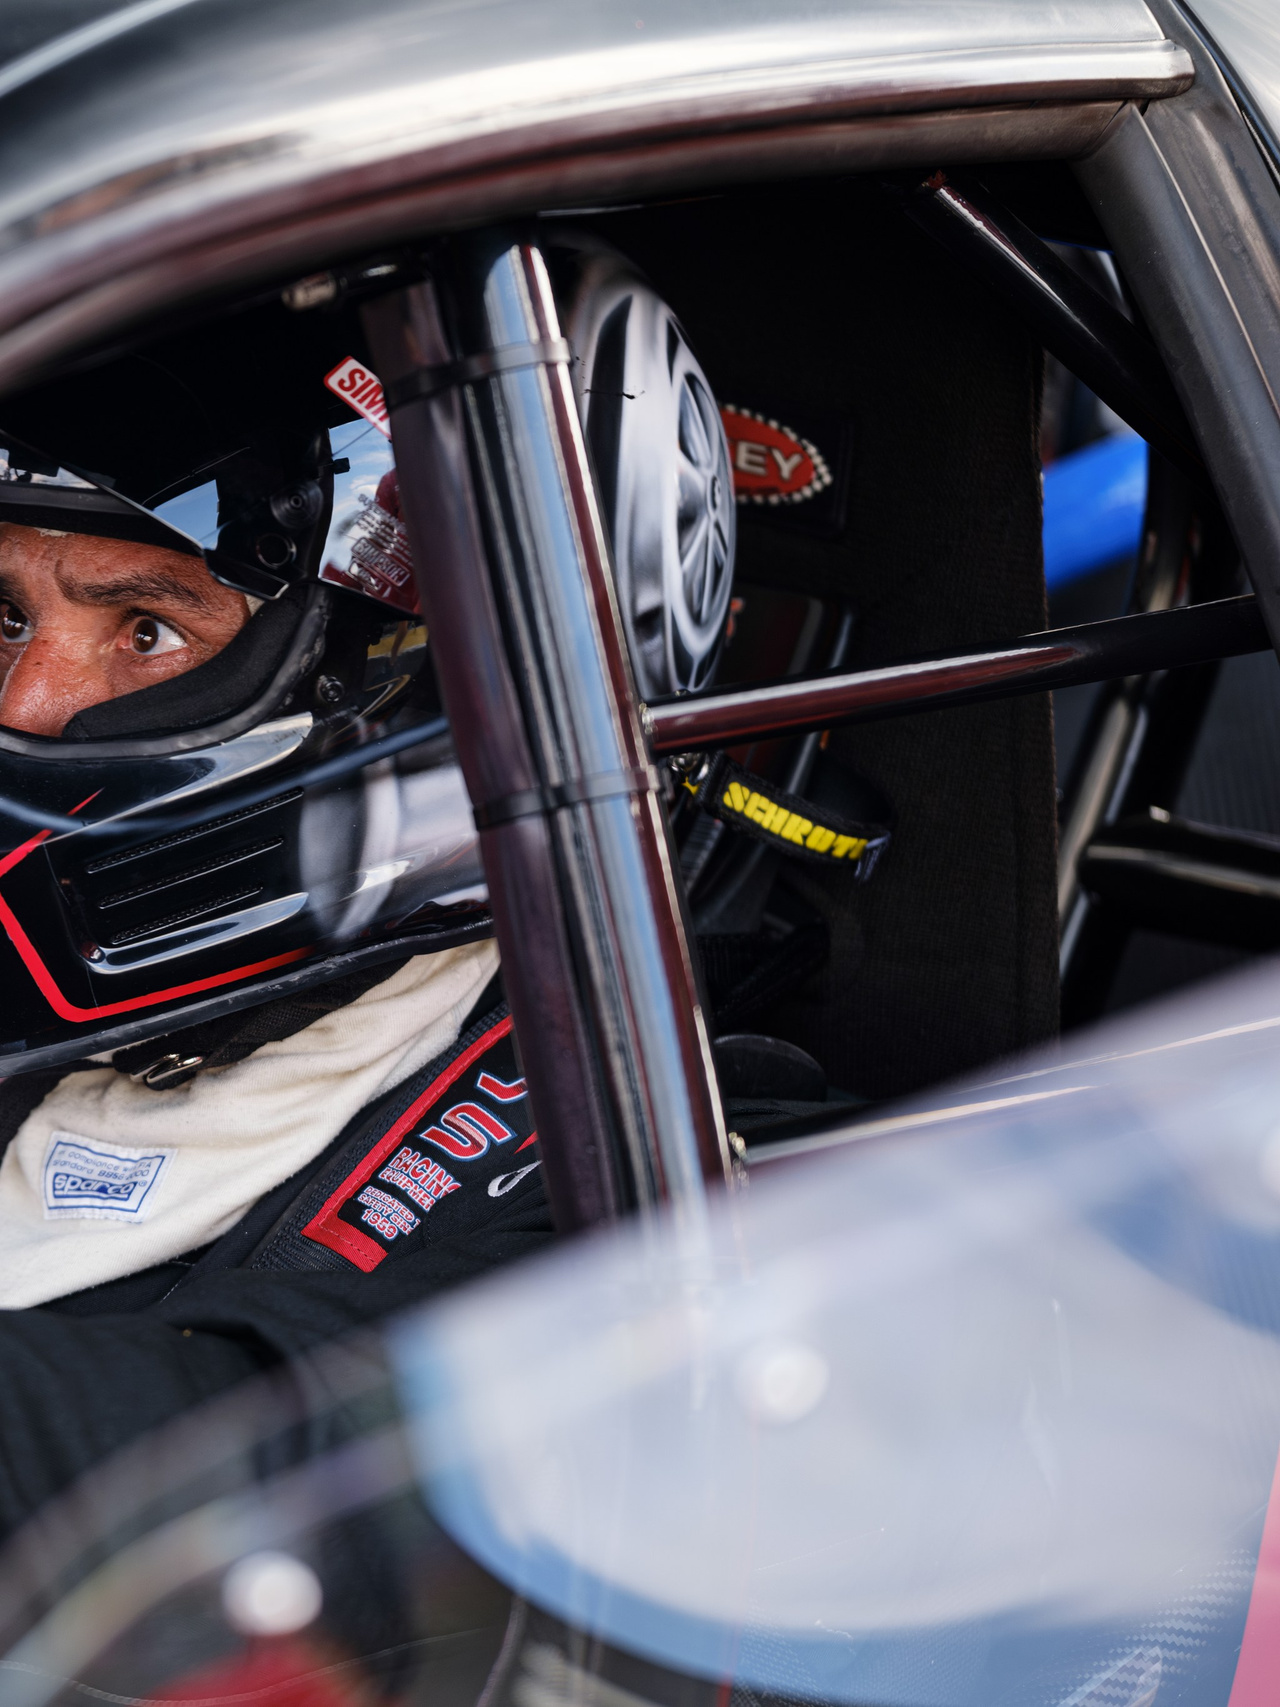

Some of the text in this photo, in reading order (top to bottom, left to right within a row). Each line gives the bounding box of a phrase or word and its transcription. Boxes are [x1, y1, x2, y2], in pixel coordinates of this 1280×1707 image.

[737, 441, 802, 481] EY
[54, 1174, 135, 1195] sparco
[379, 1167, 436, 1212] EQUIPMEN
[357, 1193, 393, 1216] SAFETY
[361, 1208, 399, 1239] 1959
